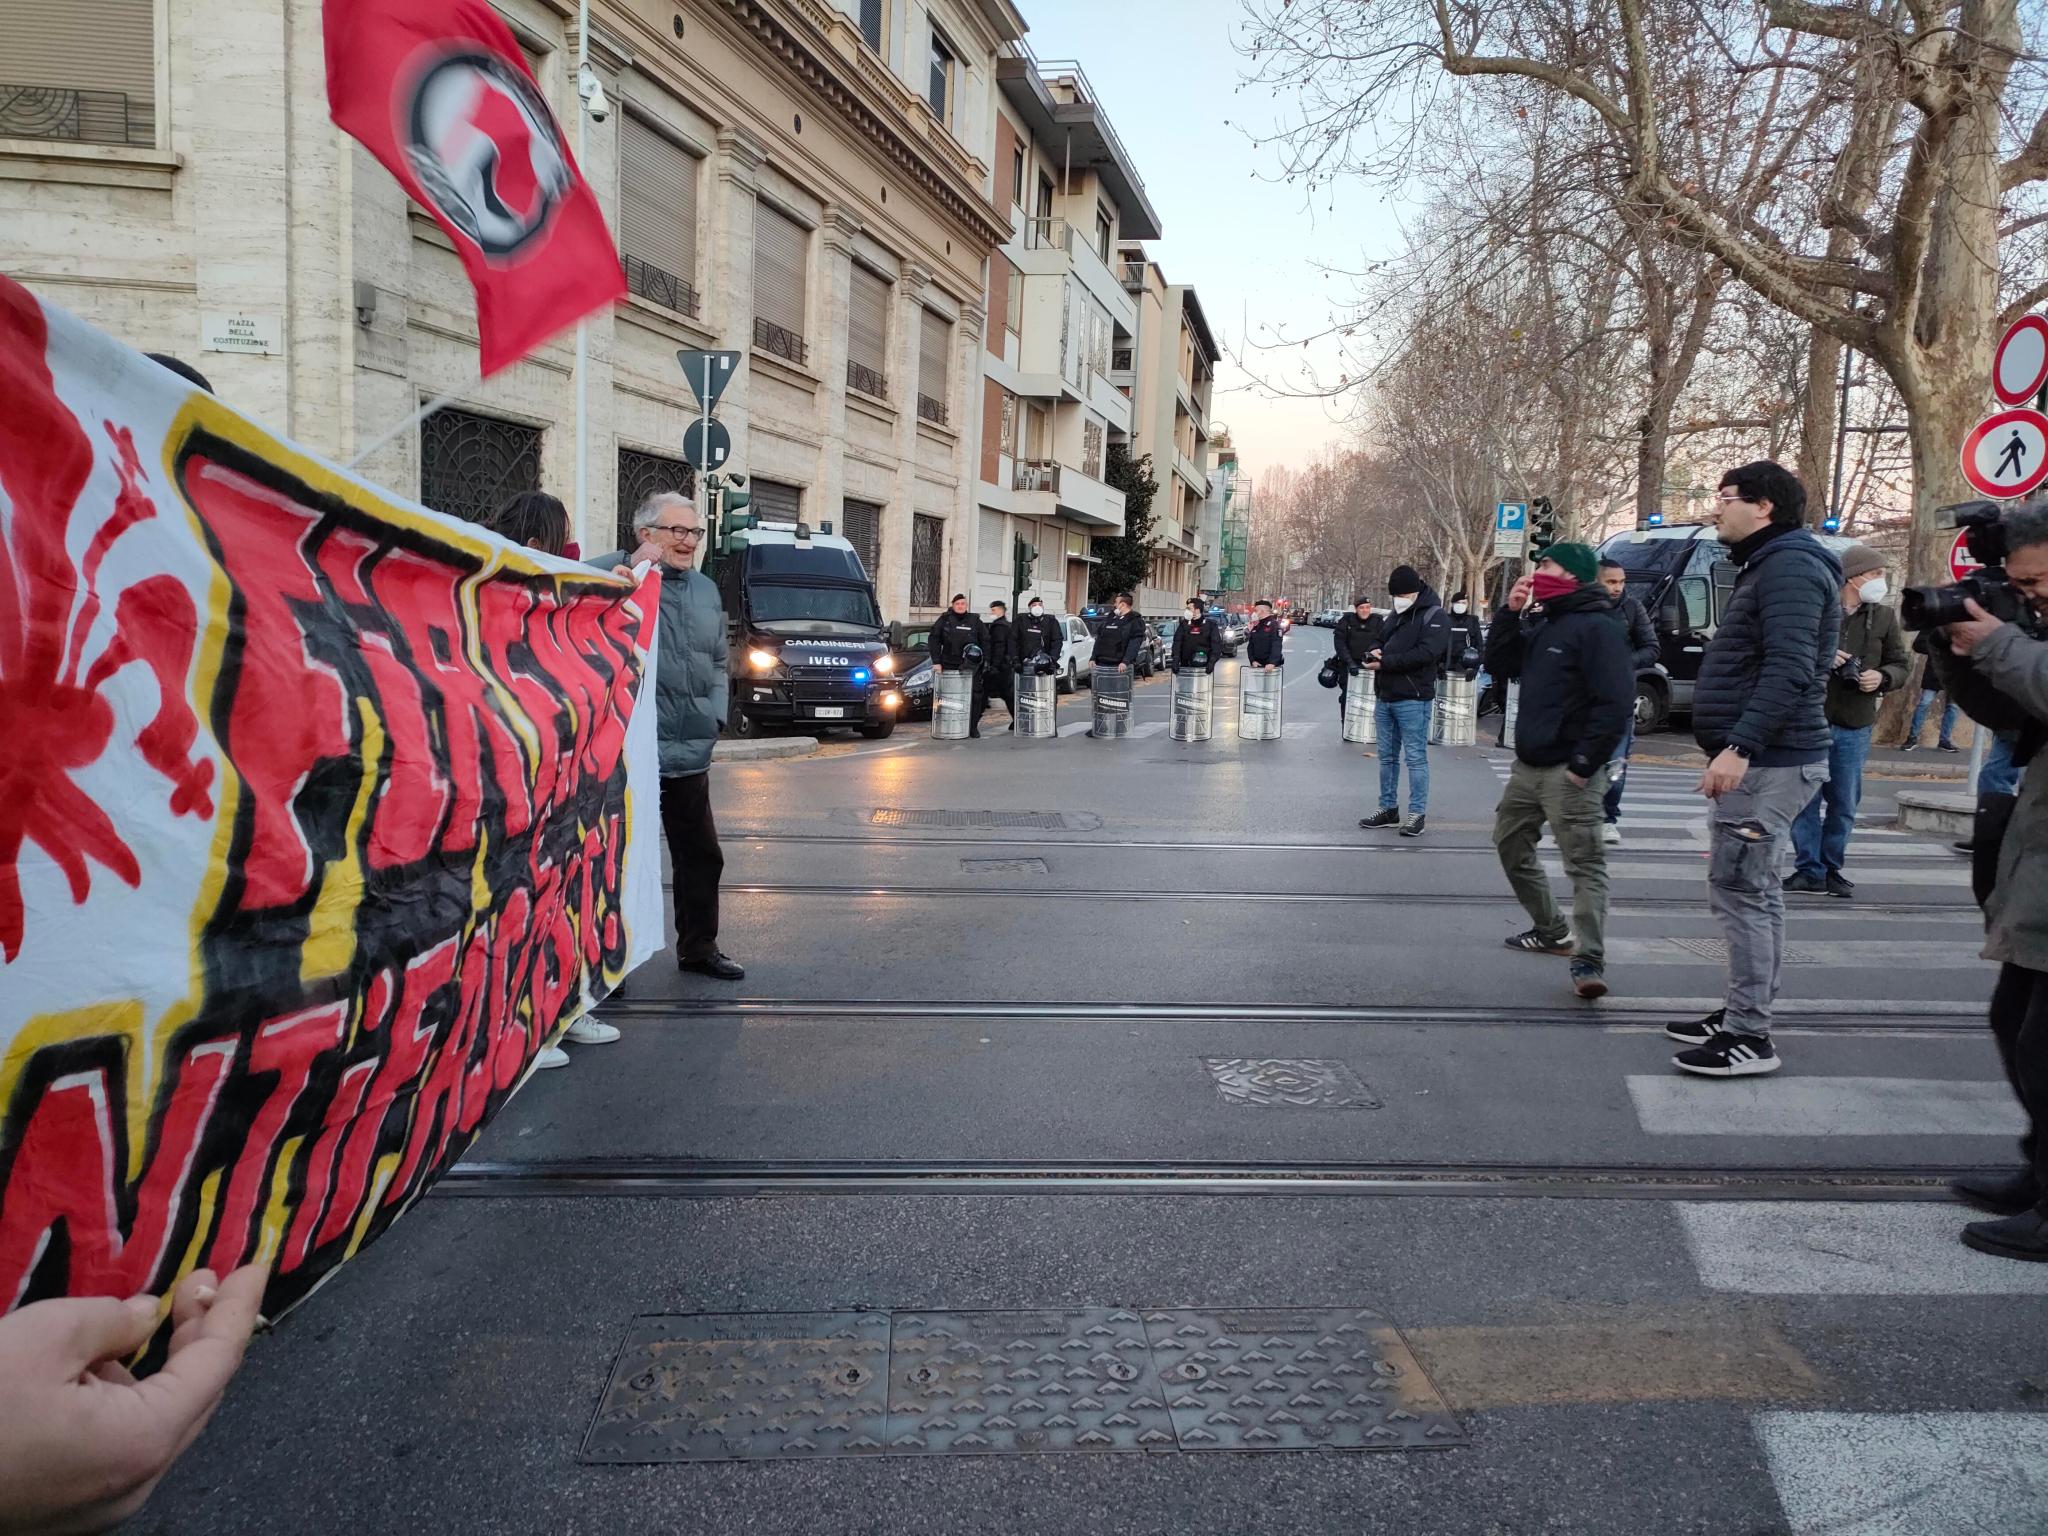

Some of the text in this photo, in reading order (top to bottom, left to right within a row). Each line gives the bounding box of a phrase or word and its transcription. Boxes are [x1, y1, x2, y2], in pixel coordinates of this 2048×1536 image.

[228, 319, 256, 327] PIAZZA
[228, 328, 254, 337] DELLA
[212, 336, 270, 347] COSTITUZIONE
[1501, 506, 1521, 528] P
[785, 639, 866, 649] CARABINIERI
[808, 656, 849, 666] IVECO
